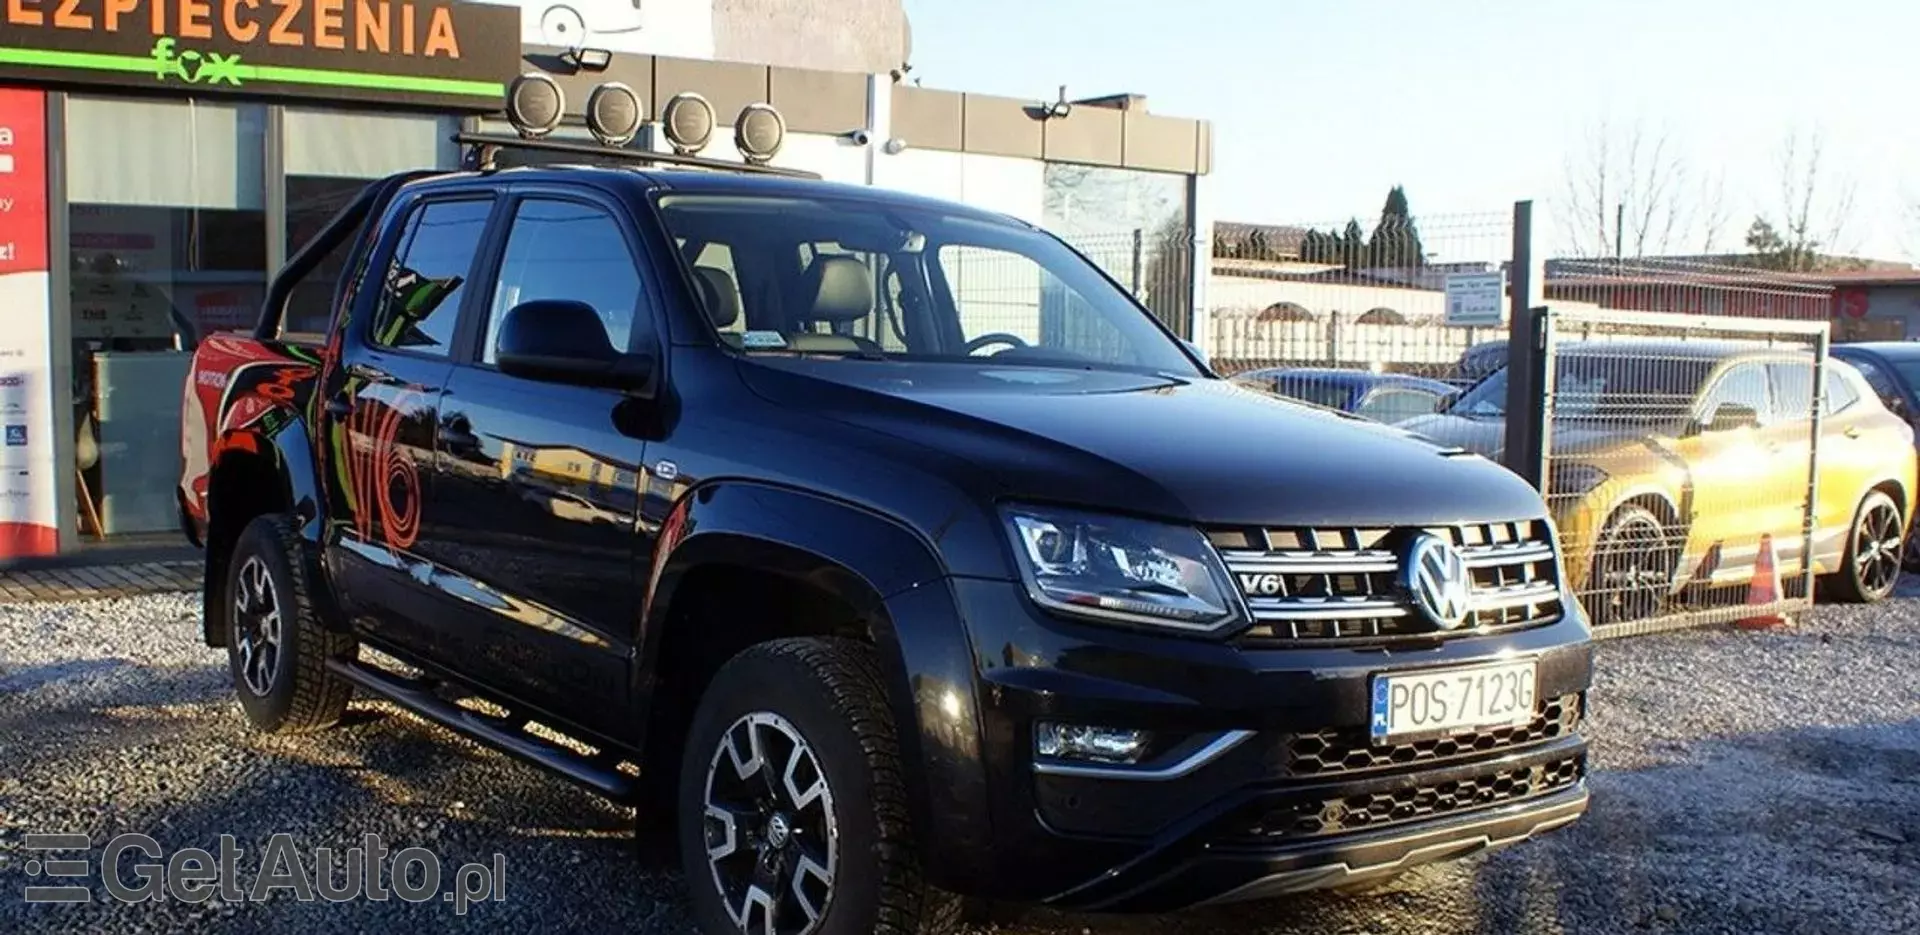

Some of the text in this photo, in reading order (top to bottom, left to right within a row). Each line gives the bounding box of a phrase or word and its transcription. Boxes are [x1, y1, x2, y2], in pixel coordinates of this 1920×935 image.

[1239, 574, 1280, 594] V6
[1390, 669, 1533, 728] POS 7123G
